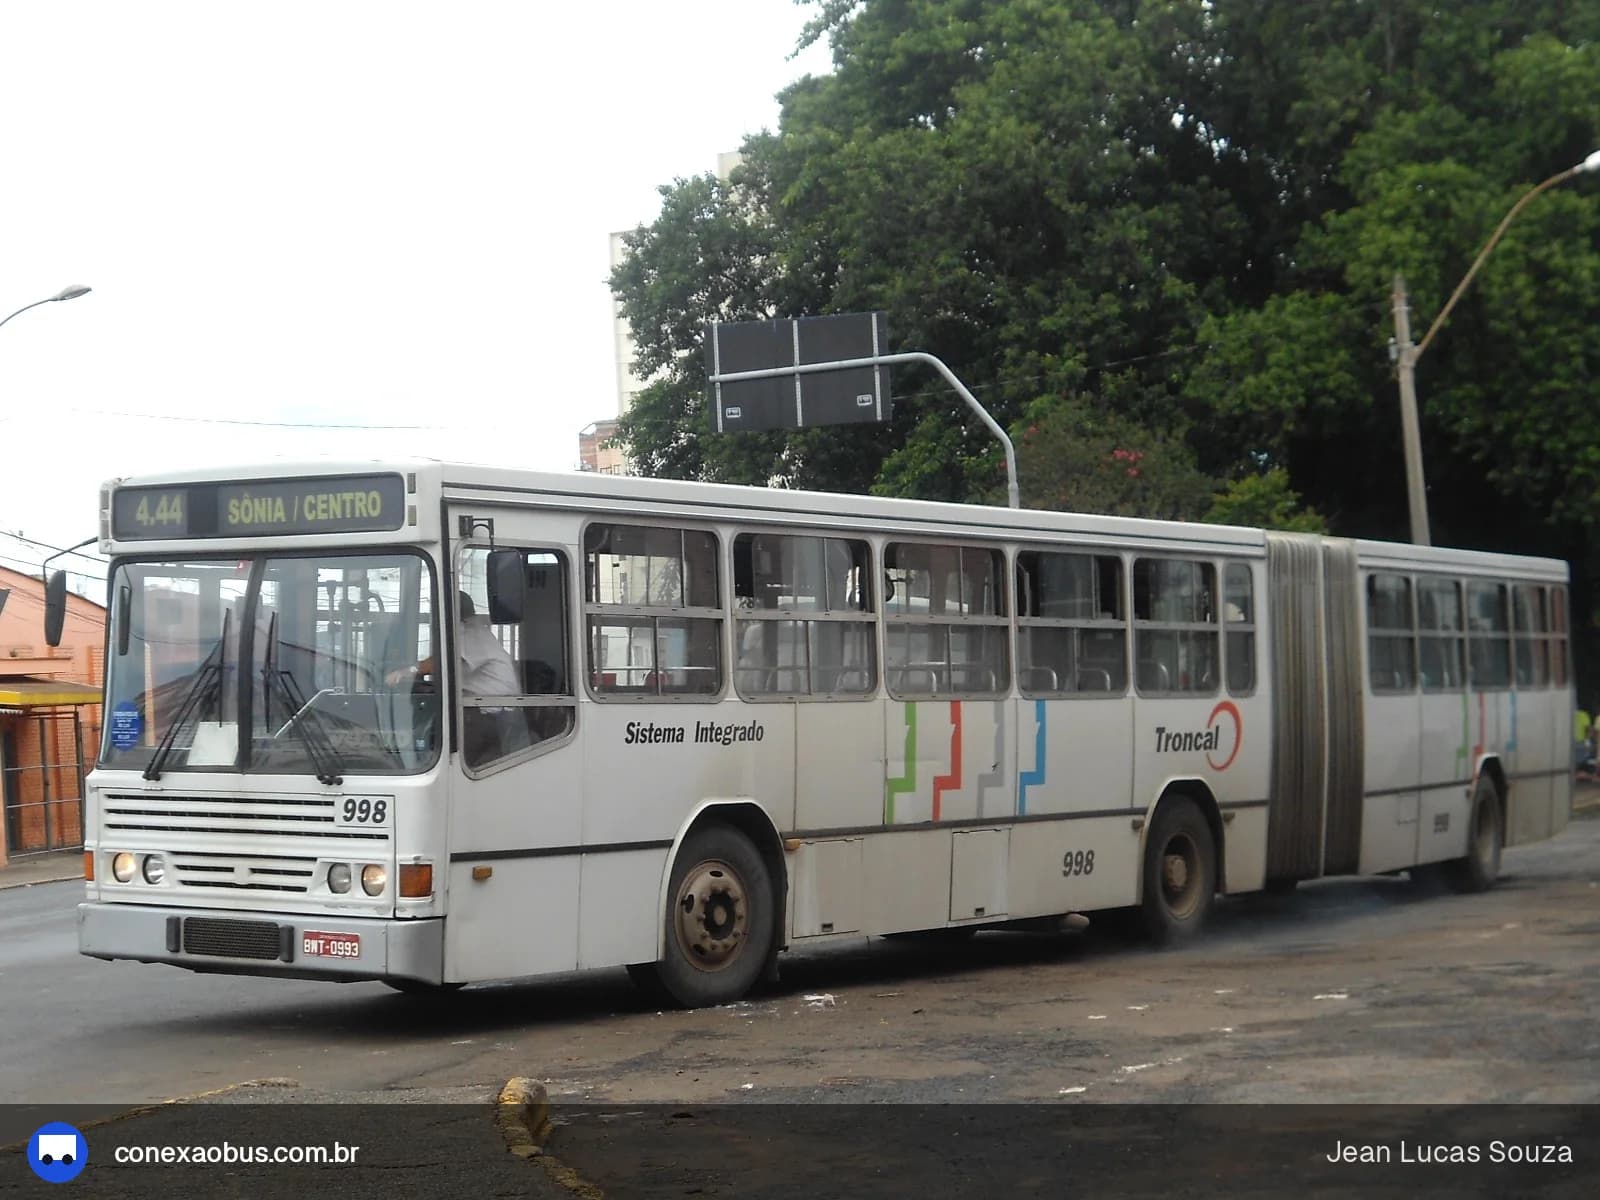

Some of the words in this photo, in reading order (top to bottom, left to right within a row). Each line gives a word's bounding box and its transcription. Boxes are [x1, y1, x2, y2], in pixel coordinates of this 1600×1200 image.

[228, 493, 286, 525] SÔNIA
[293, 495, 299, 522] /
[303, 490, 382, 521] CENTRO
[624, 721, 685, 744] Sistema
[694, 719, 764, 746] Integrado
[1155, 725, 1220, 752] Troncal
[342, 798, 387, 823] 998
[1063, 850, 1095, 877] 998
